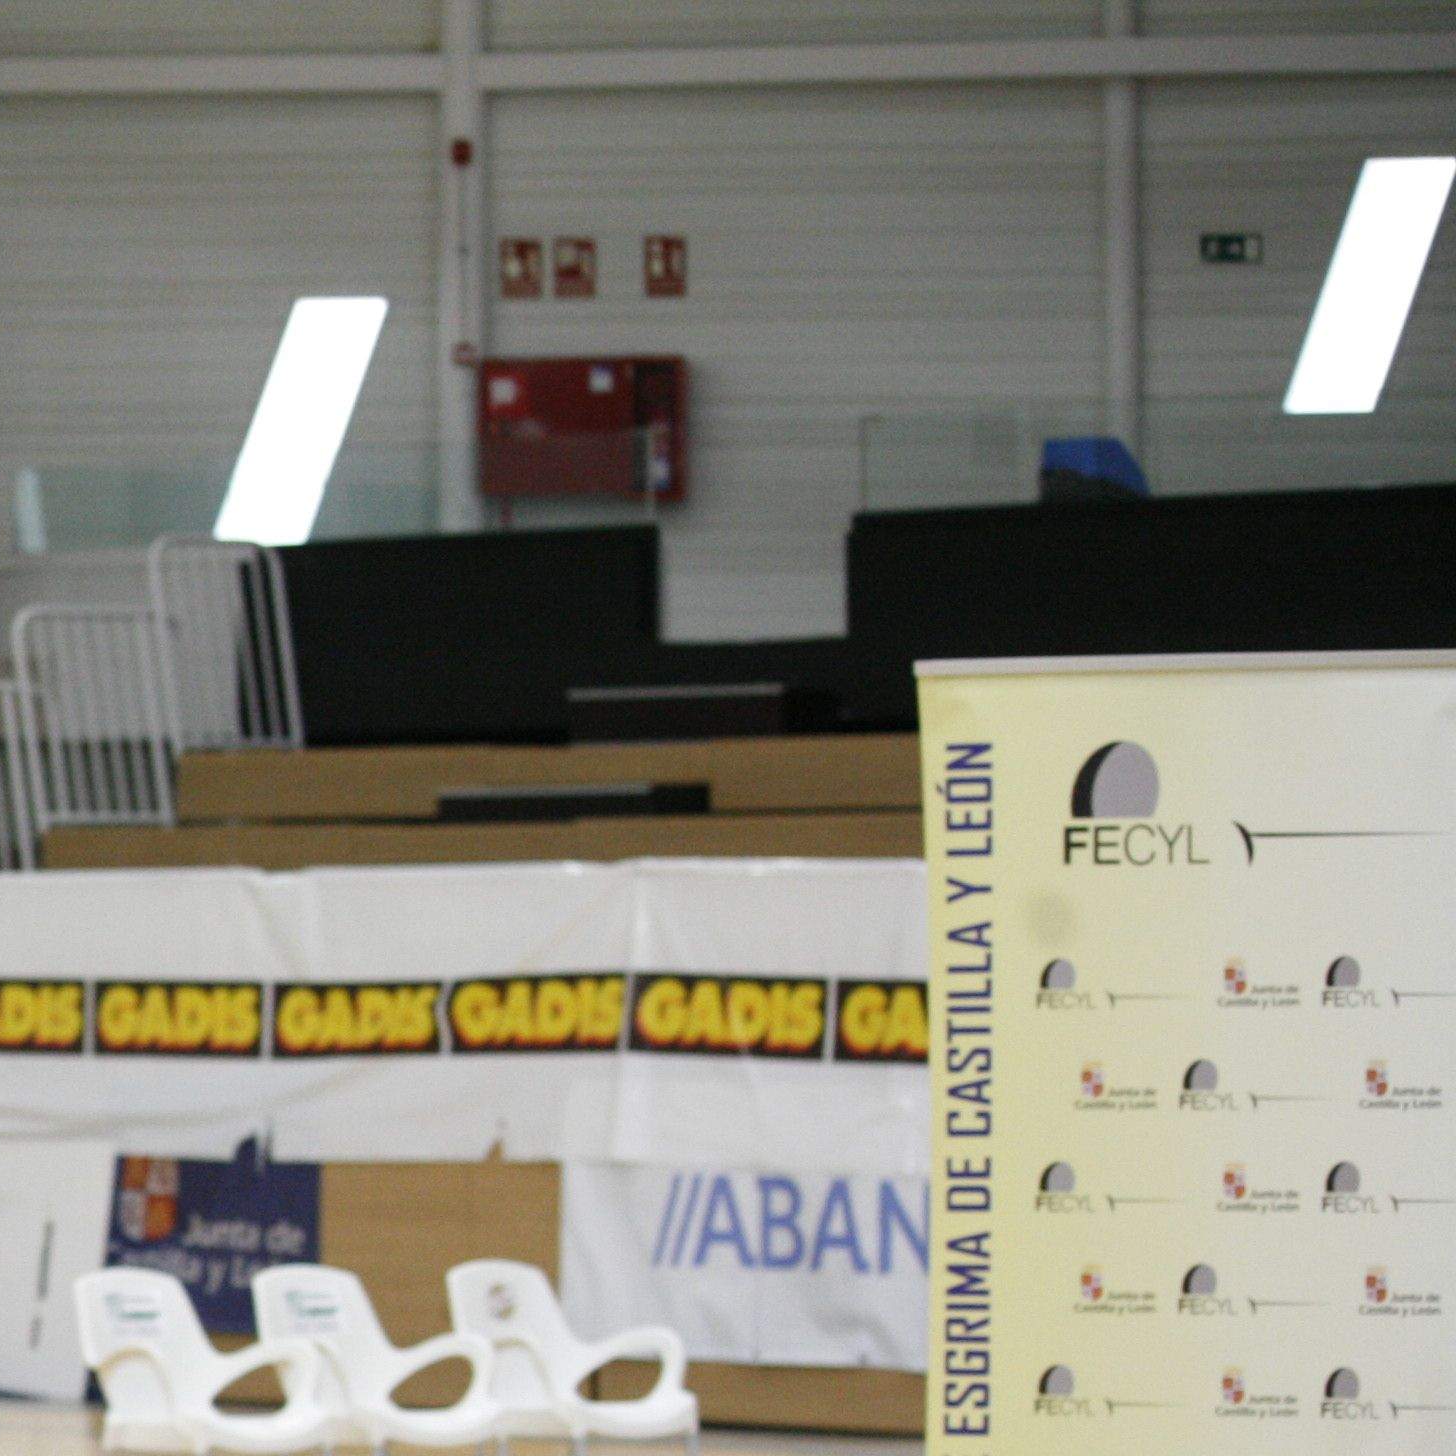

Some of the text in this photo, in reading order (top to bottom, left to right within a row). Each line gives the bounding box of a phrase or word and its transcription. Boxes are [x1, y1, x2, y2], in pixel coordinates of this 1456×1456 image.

[936, 741, 994, 858] LEÓN
[1063, 825, 1211, 866] FECYL
[946, 877, 994, 905] Y
[841, 983, 928, 1054] GA
[1321, 989, 1379, 1007] FECYL
[946, 921, 993, 1138] CASTILLA
[946, 1158, 992, 1213] DE
[1320, 1195, 1379, 1213] FECYL
[943, 1231, 992, 1437] ESGRIMA
[1319, 1401, 1379, 1419] FECYL
